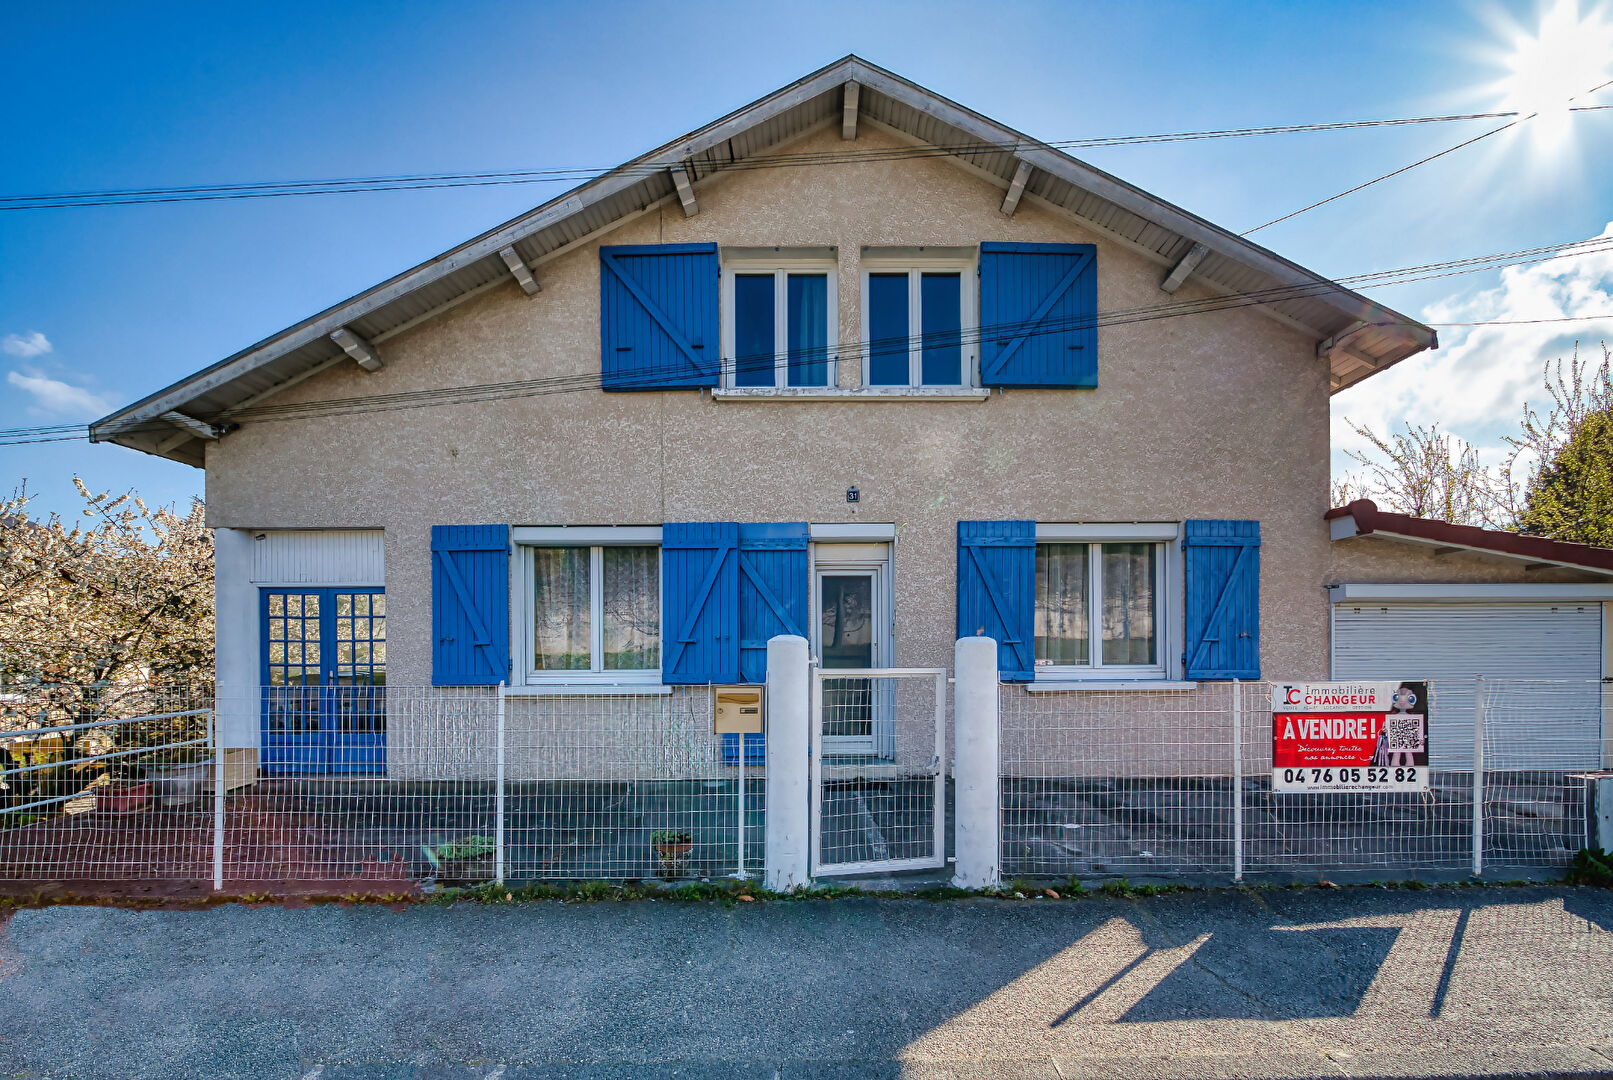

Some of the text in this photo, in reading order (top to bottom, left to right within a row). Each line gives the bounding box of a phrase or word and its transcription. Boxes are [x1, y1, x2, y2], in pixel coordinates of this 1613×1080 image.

[849, 492, 857, 500] 31
[1305, 685, 1376, 695] Immobilière
[1305, 695, 1376, 705] CHANGEUR
[1283, 716, 1296, 740] À
[1284, 767, 1417, 784] 04 76 05 52 82
